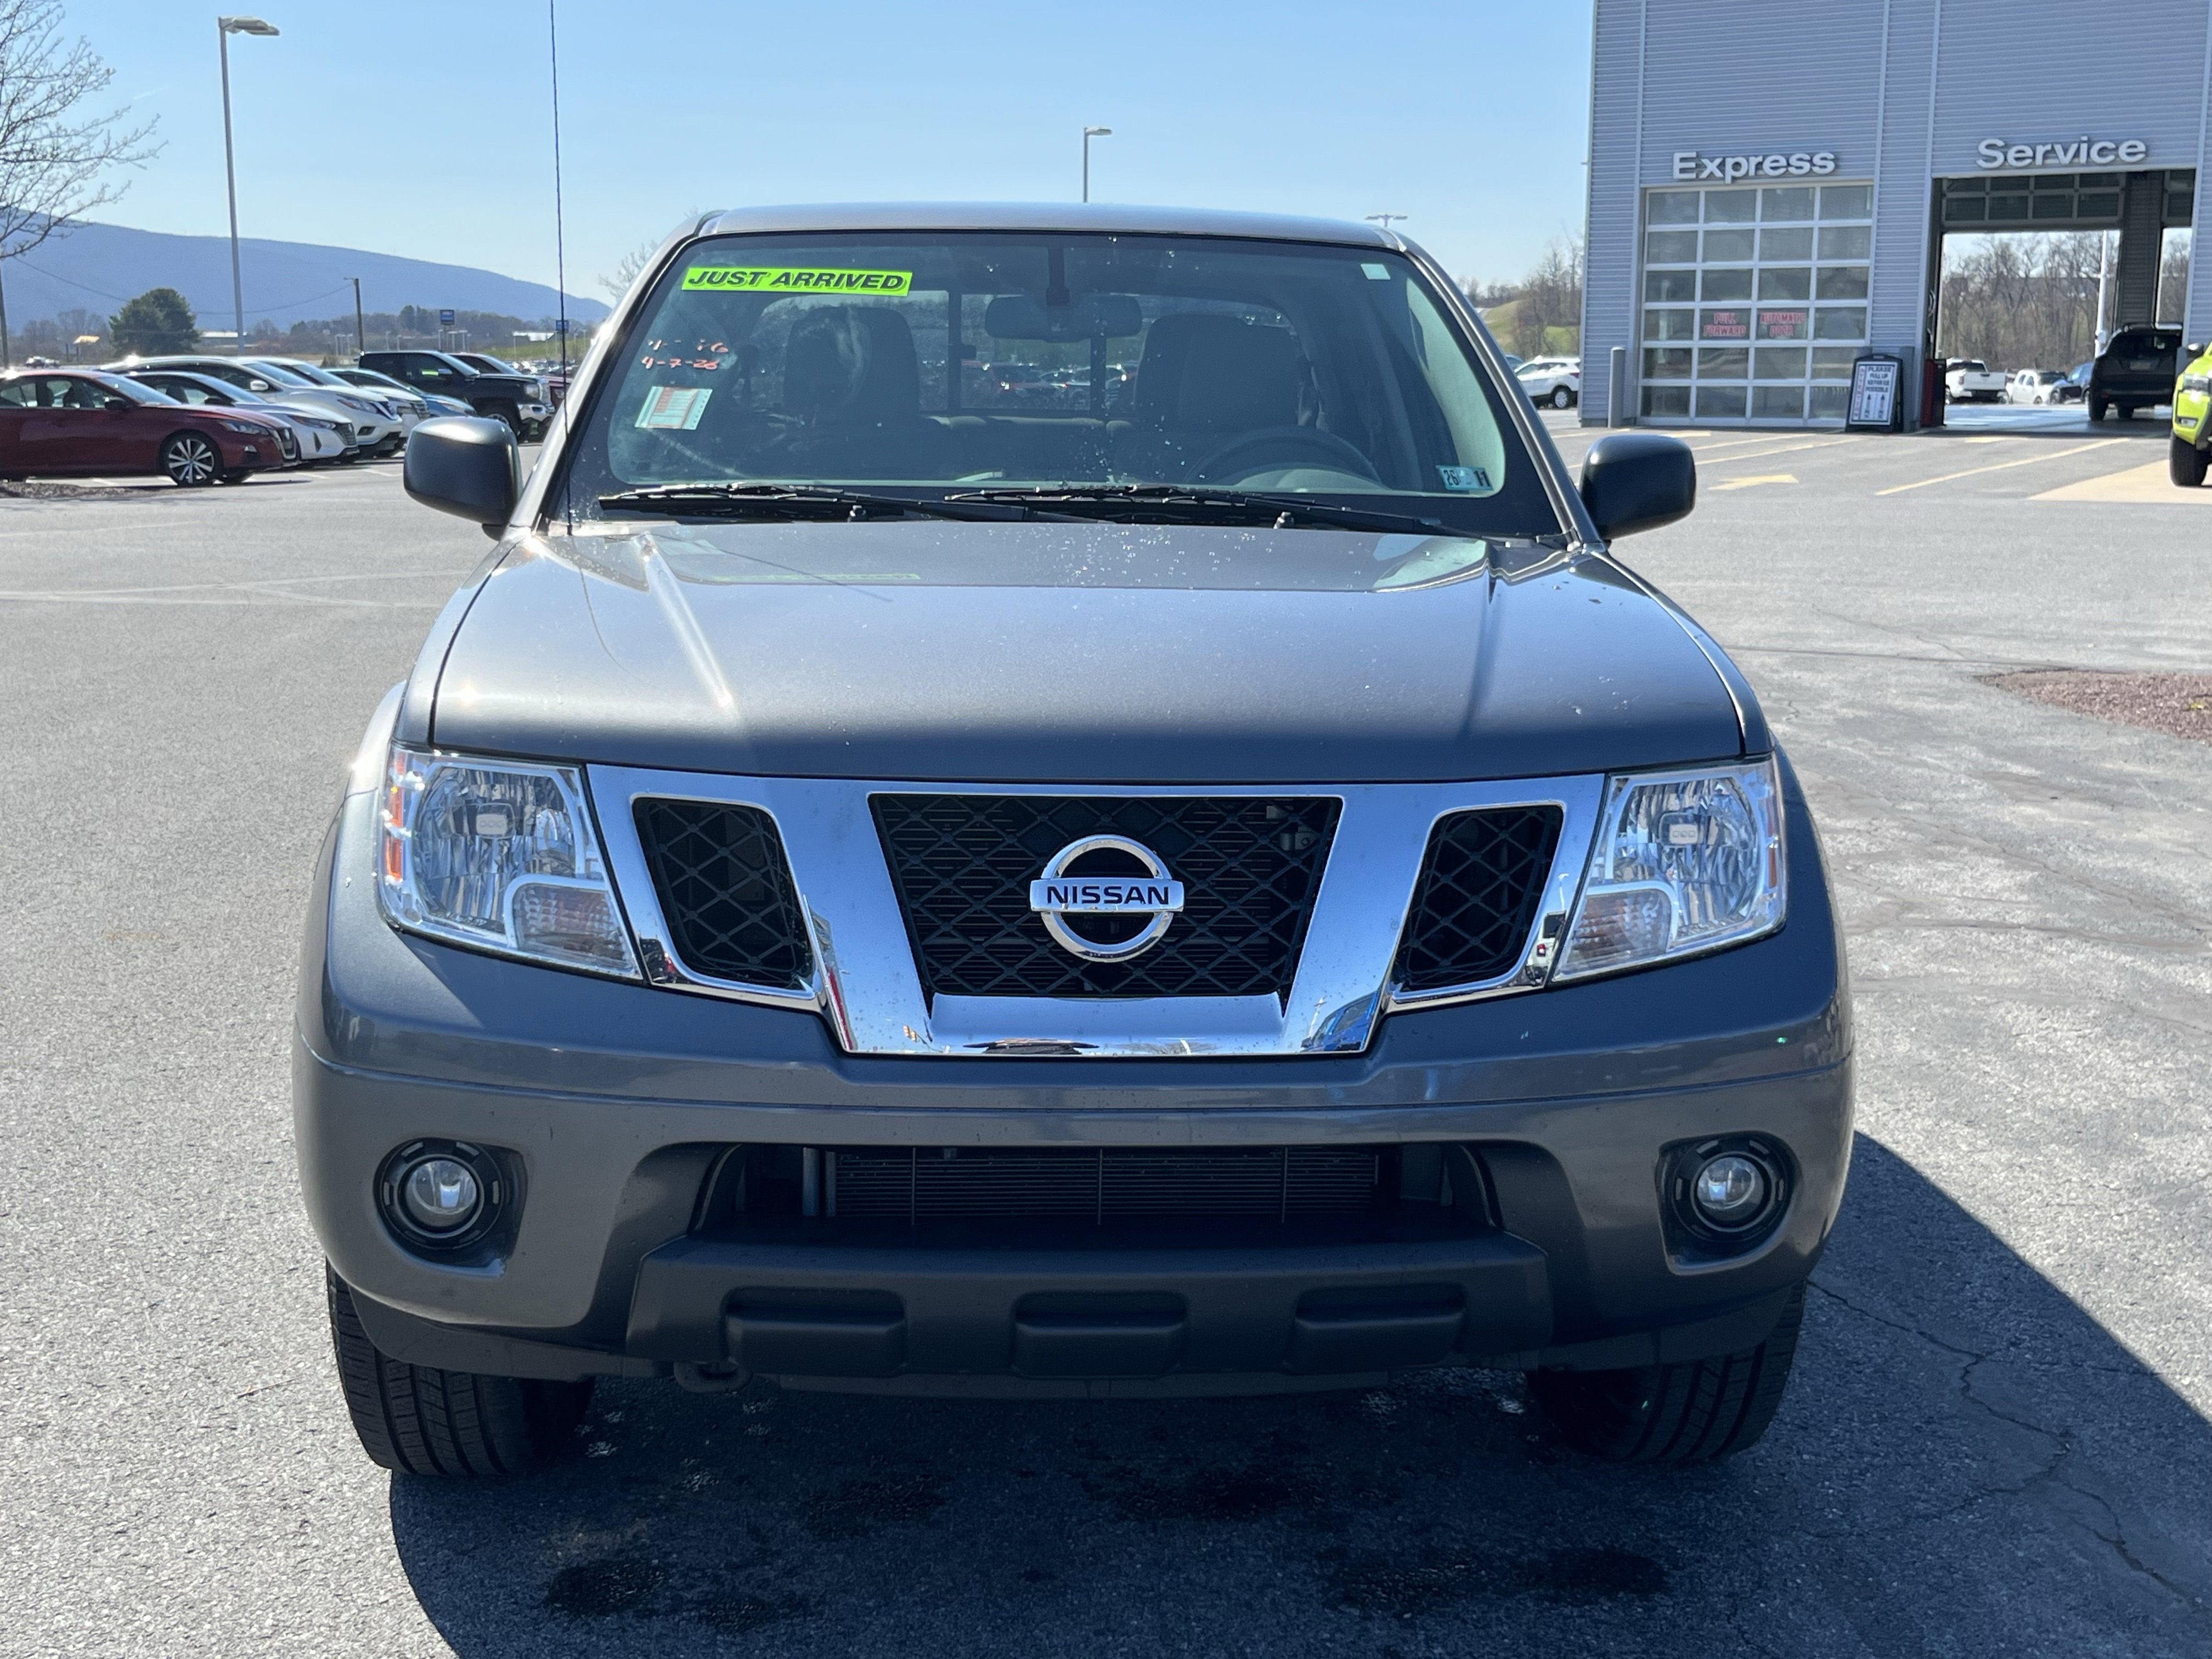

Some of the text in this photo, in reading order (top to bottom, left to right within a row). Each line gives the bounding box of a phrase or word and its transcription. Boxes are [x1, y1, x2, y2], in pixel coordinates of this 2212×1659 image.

[1976, 136, 2146, 169] Service
[1673, 151, 1836, 184] Express
[688, 270, 907, 290] JUST ARRIVED
[1443, 469, 1460, 486] 26
[1047, 885, 1169, 905] NISSAN
